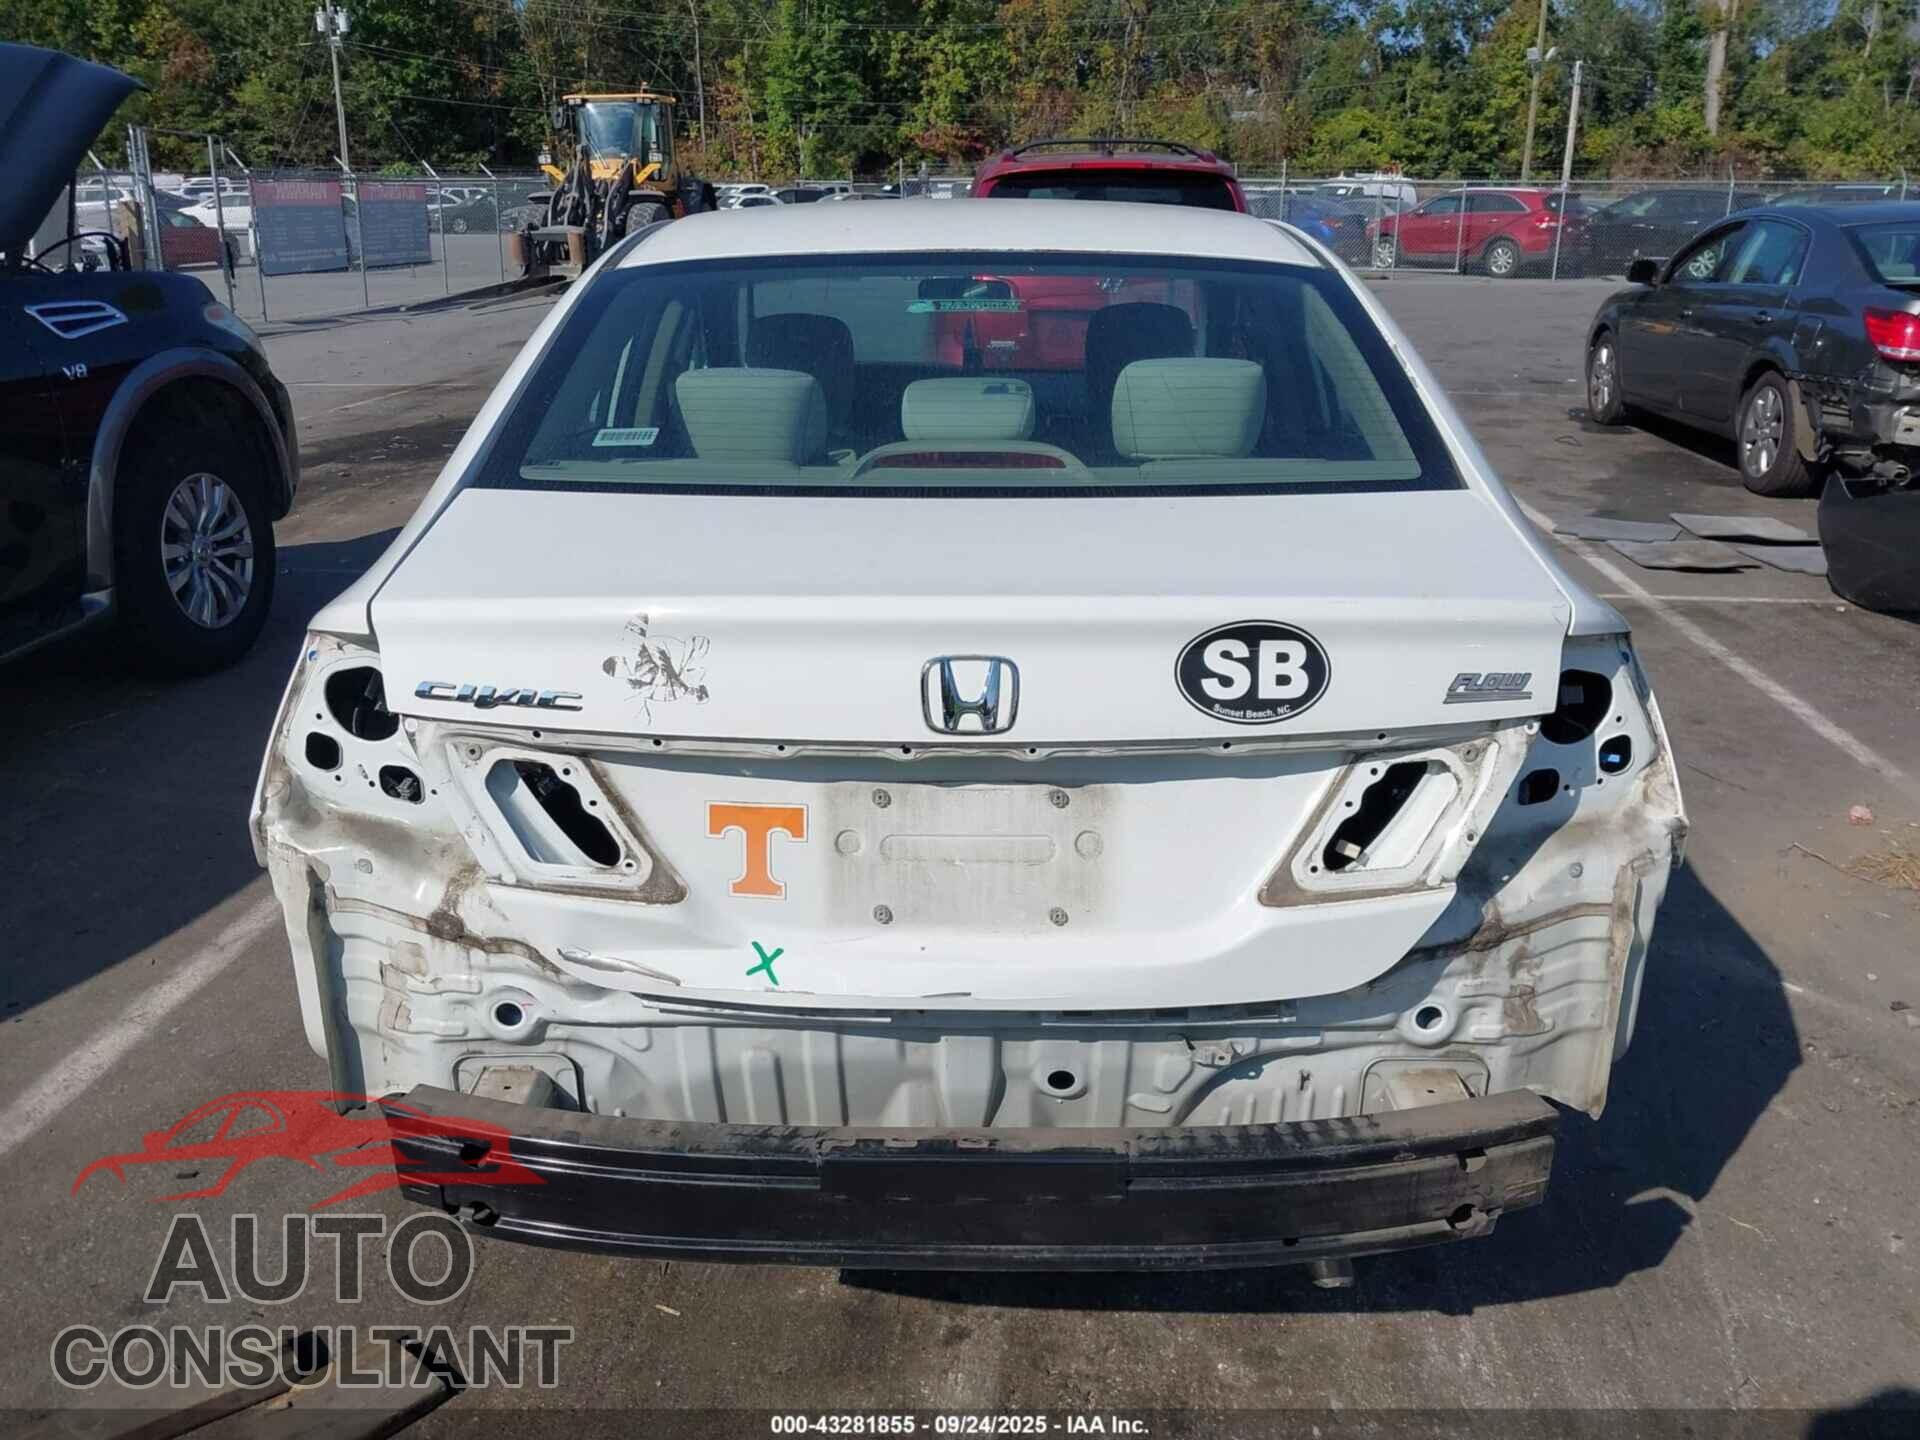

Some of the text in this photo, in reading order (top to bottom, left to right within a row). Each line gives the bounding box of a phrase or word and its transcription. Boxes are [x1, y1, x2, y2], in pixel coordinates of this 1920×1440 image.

[1201, 639, 1309, 700] SB
[1448, 672, 1532, 692] FLOW
[415, 680, 583, 711] CIVIC
[1213, 703, 1244, 718] Sunset
[1277, 704, 1291, 715] NC
[706, 802, 807, 898] T
